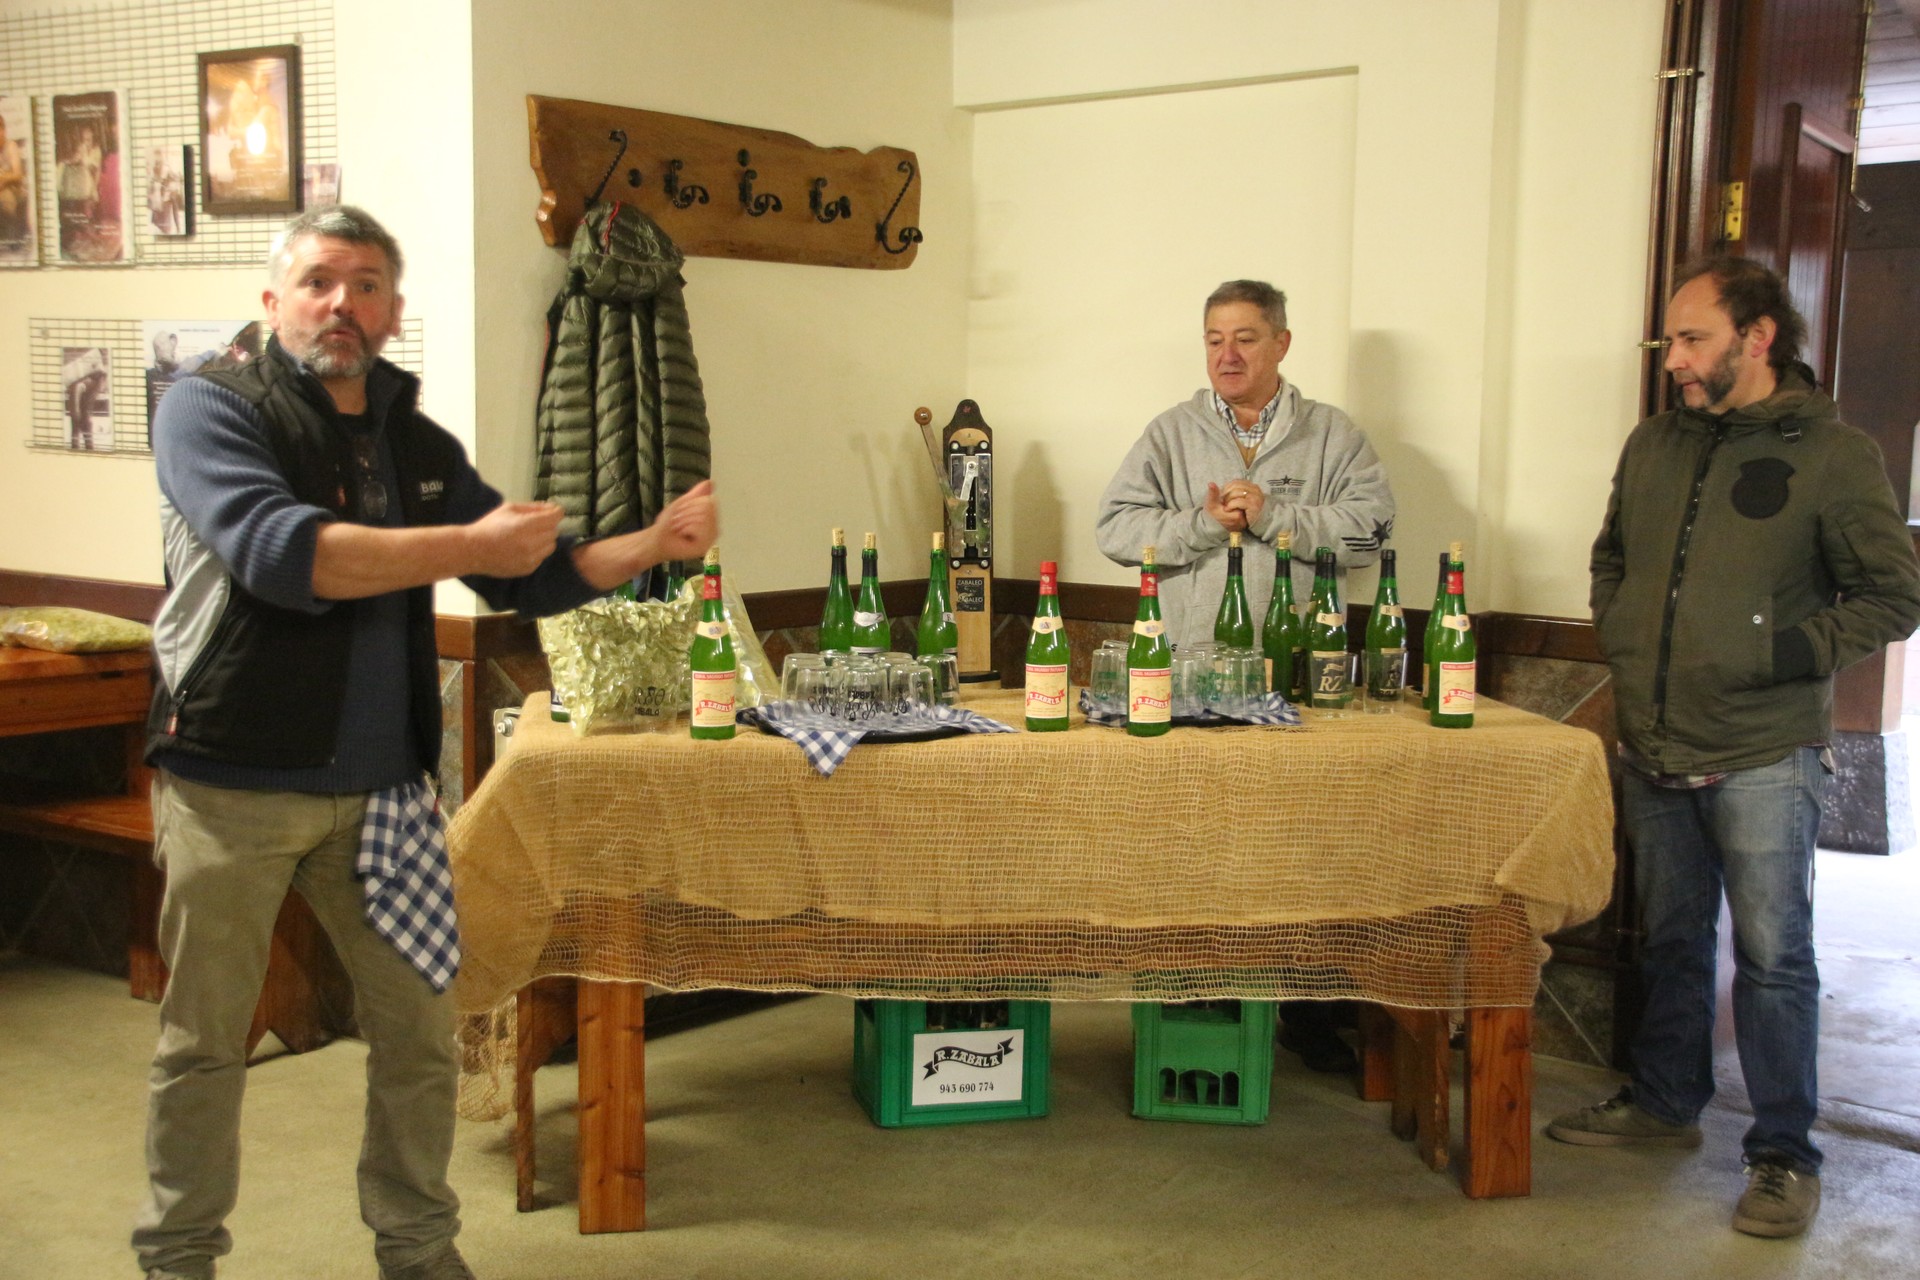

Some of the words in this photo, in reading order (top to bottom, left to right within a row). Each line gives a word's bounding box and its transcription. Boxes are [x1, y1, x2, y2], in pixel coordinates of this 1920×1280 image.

[940, 1083, 956, 1093] 943
[959, 1083, 976, 1093] 690
[979, 1082, 994, 1091] 774
